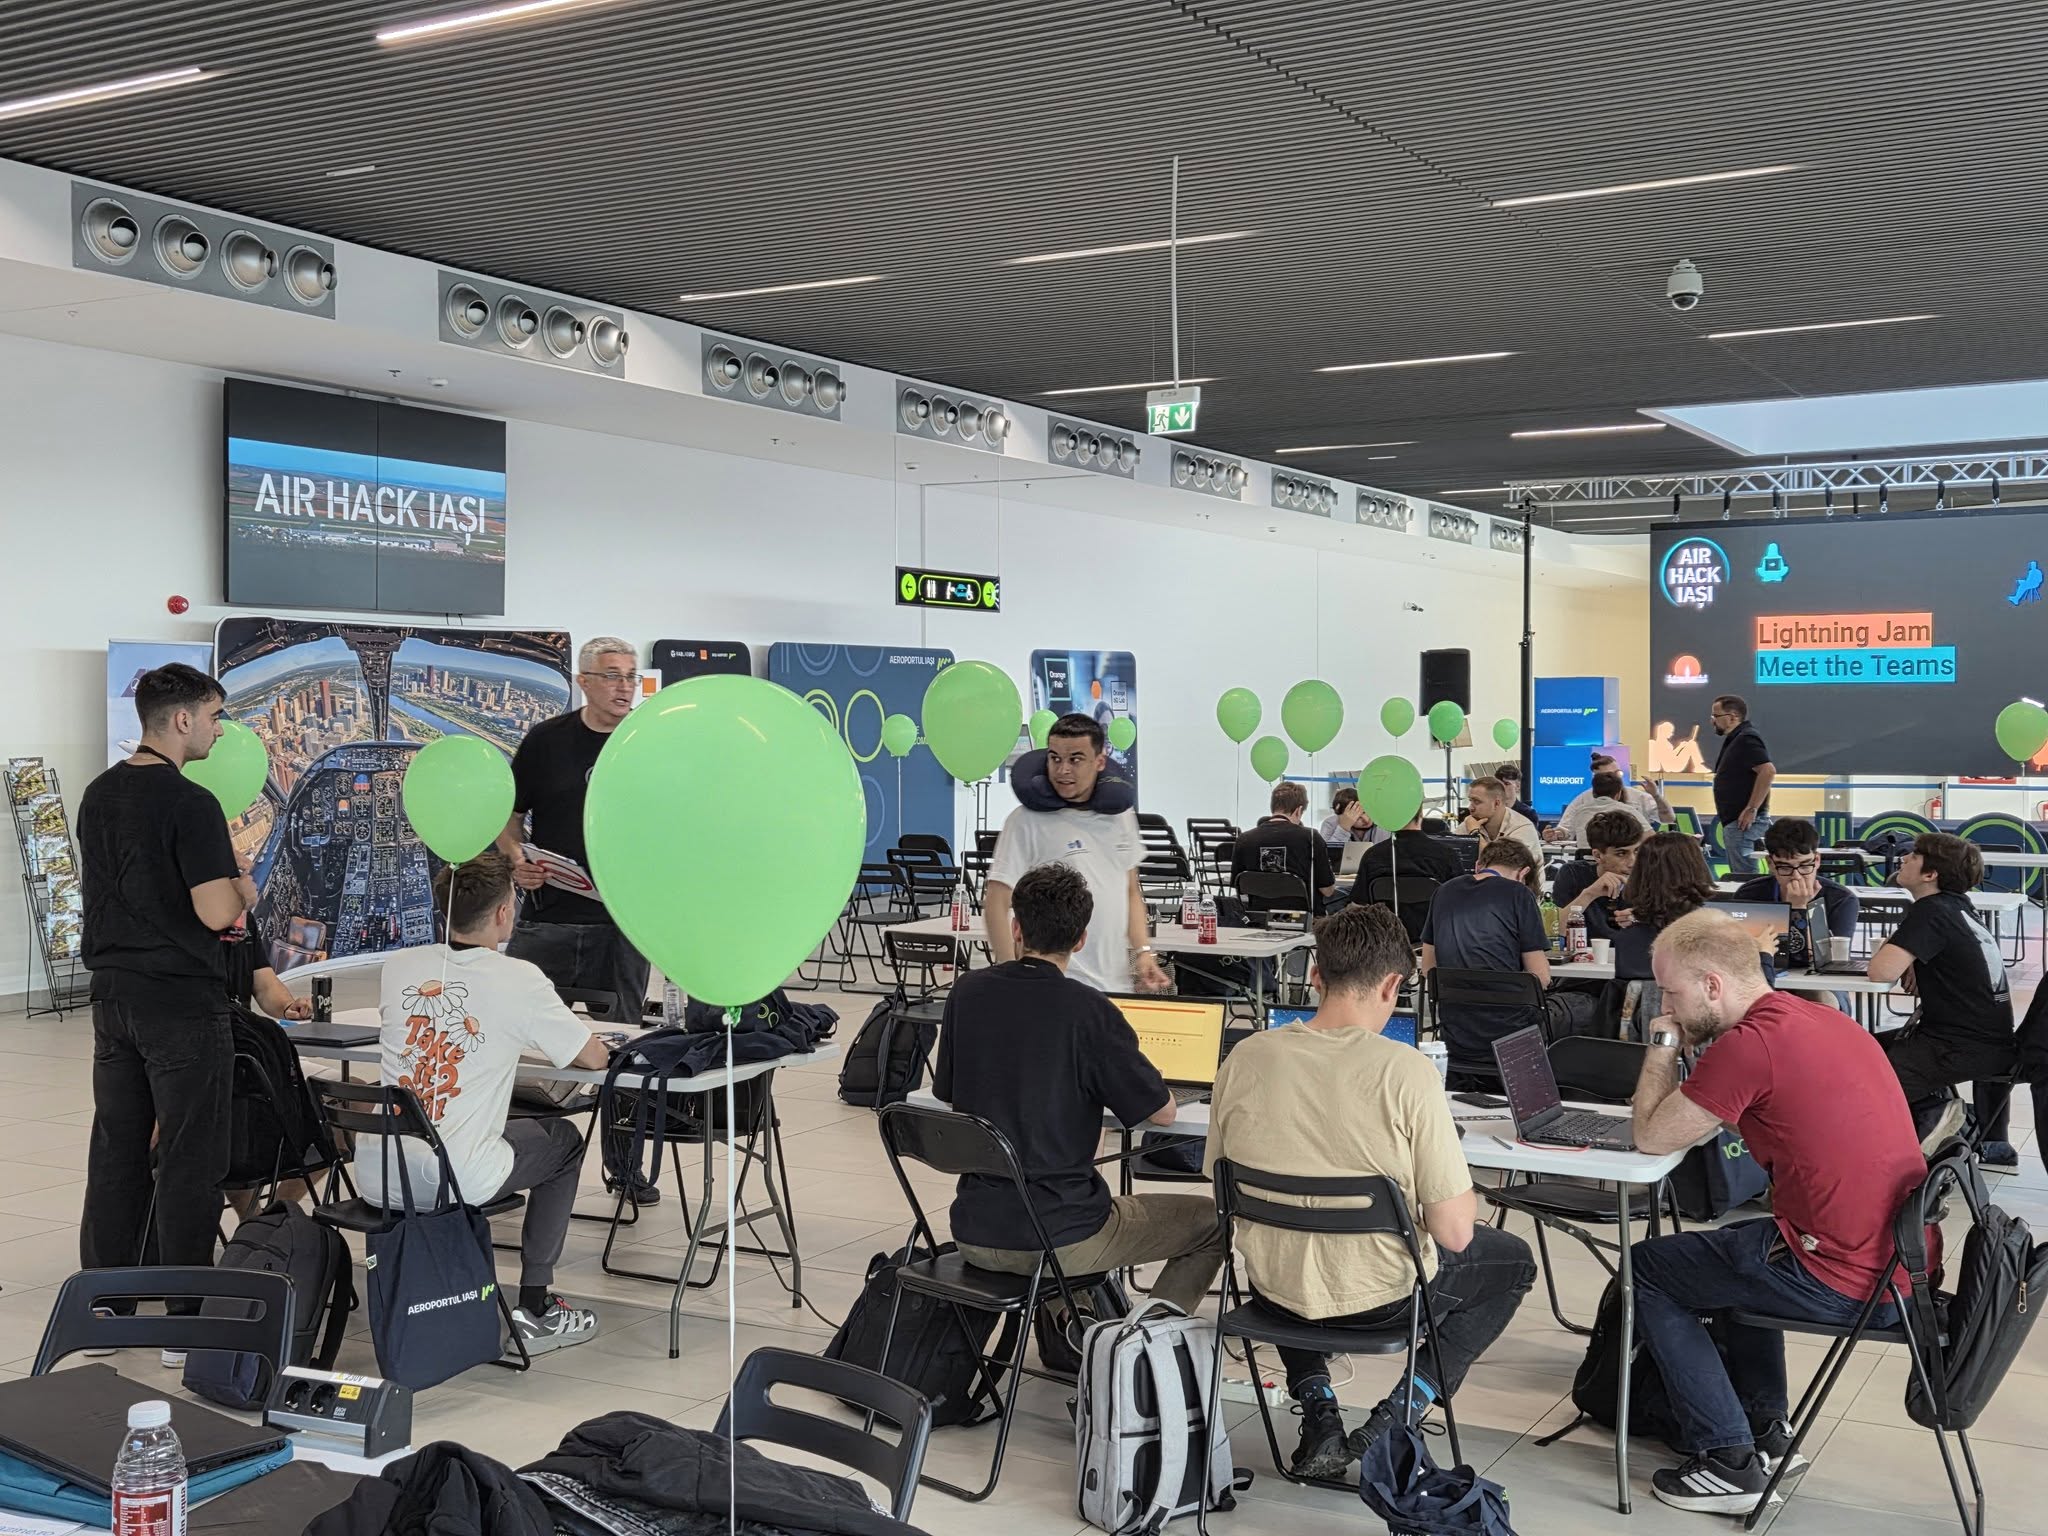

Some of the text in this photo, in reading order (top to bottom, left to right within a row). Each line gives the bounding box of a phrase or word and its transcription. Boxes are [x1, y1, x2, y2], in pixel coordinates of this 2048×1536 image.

[255, 473, 485, 546] AIR HACK IAȘI
[1678, 547, 1712, 565] AIR
[1668, 566, 1722, 585] HACK
[1676, 585, 1714, 609] IAȘI
[1759, 620, 1931, 649] Lightning Jam
[889, 655, 925, 665] AEROPORTUL
[1759, 654, 1954, 677] Meet the Teams
[1049, 670, 1066, 680] Orange
[1054, 680, 1064, 688] Fab
[1554, 777, 1585, 785] AIRPORT
[405, 1015, 465, 1065] Take
[407, 1295, 461, 1316] AEROPORTUL
